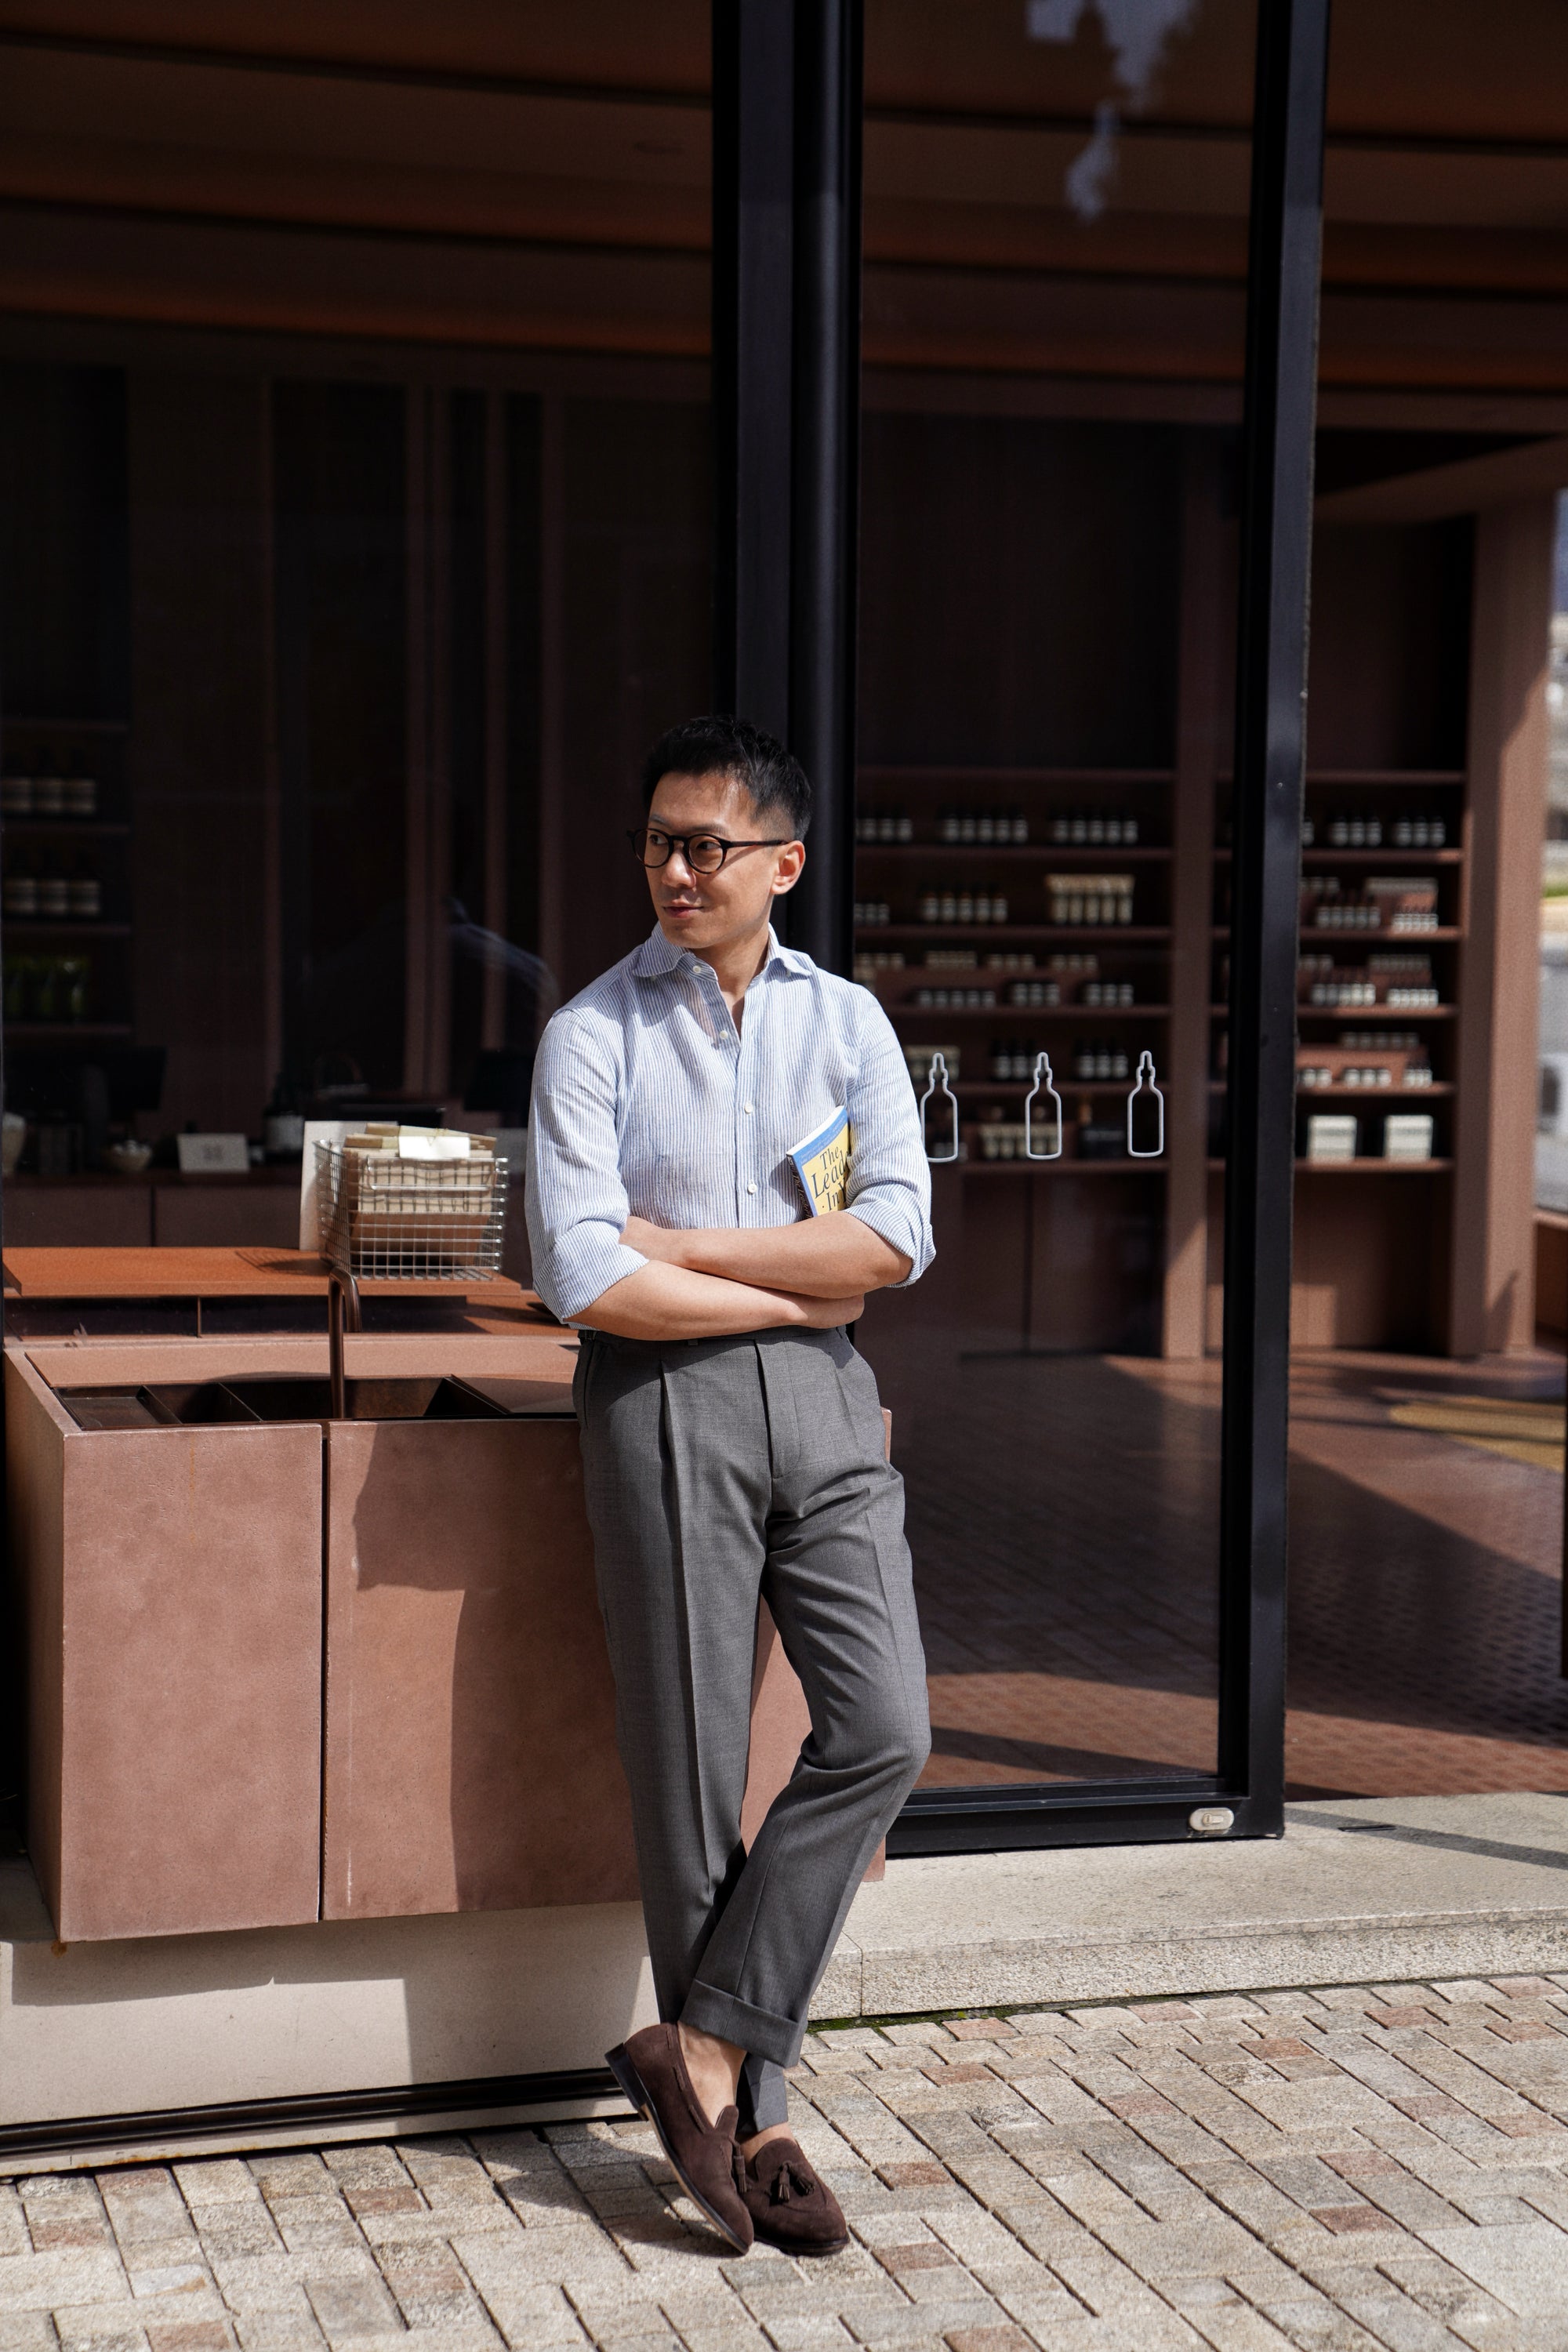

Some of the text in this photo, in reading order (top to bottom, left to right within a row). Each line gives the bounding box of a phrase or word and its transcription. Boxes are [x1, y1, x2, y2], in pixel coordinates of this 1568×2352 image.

[820, 1146, 839, 1171] The
[811, 1149, 848, 1199] Lead
[826, 1191, 840, 1210] In
